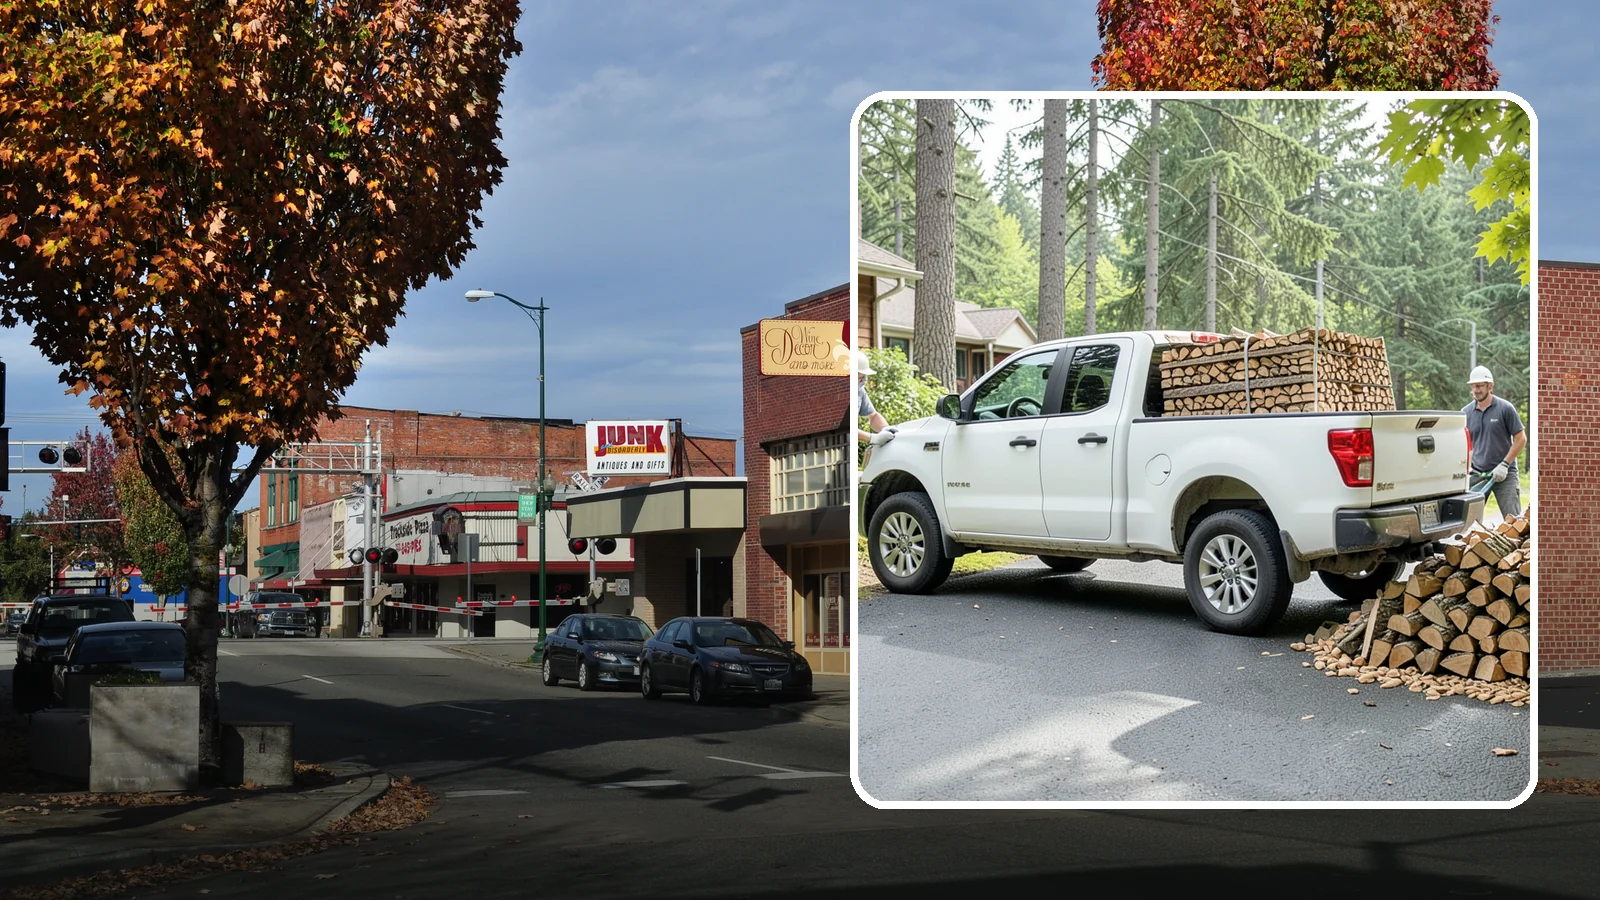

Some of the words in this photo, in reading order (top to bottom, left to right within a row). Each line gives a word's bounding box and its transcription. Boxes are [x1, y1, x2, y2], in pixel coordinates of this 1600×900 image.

[791, 325, 824, 345] Wine
[765, 328, 831, 366] Decor
[595, 425, 664, 457] JUNK
[607, 446, 646, 454] DISORDERLY
[597, 461, 628, 470] ANTIQUES
[631, 461, 644, 470] AND
[647, 460, 665, 470] GIFTS
